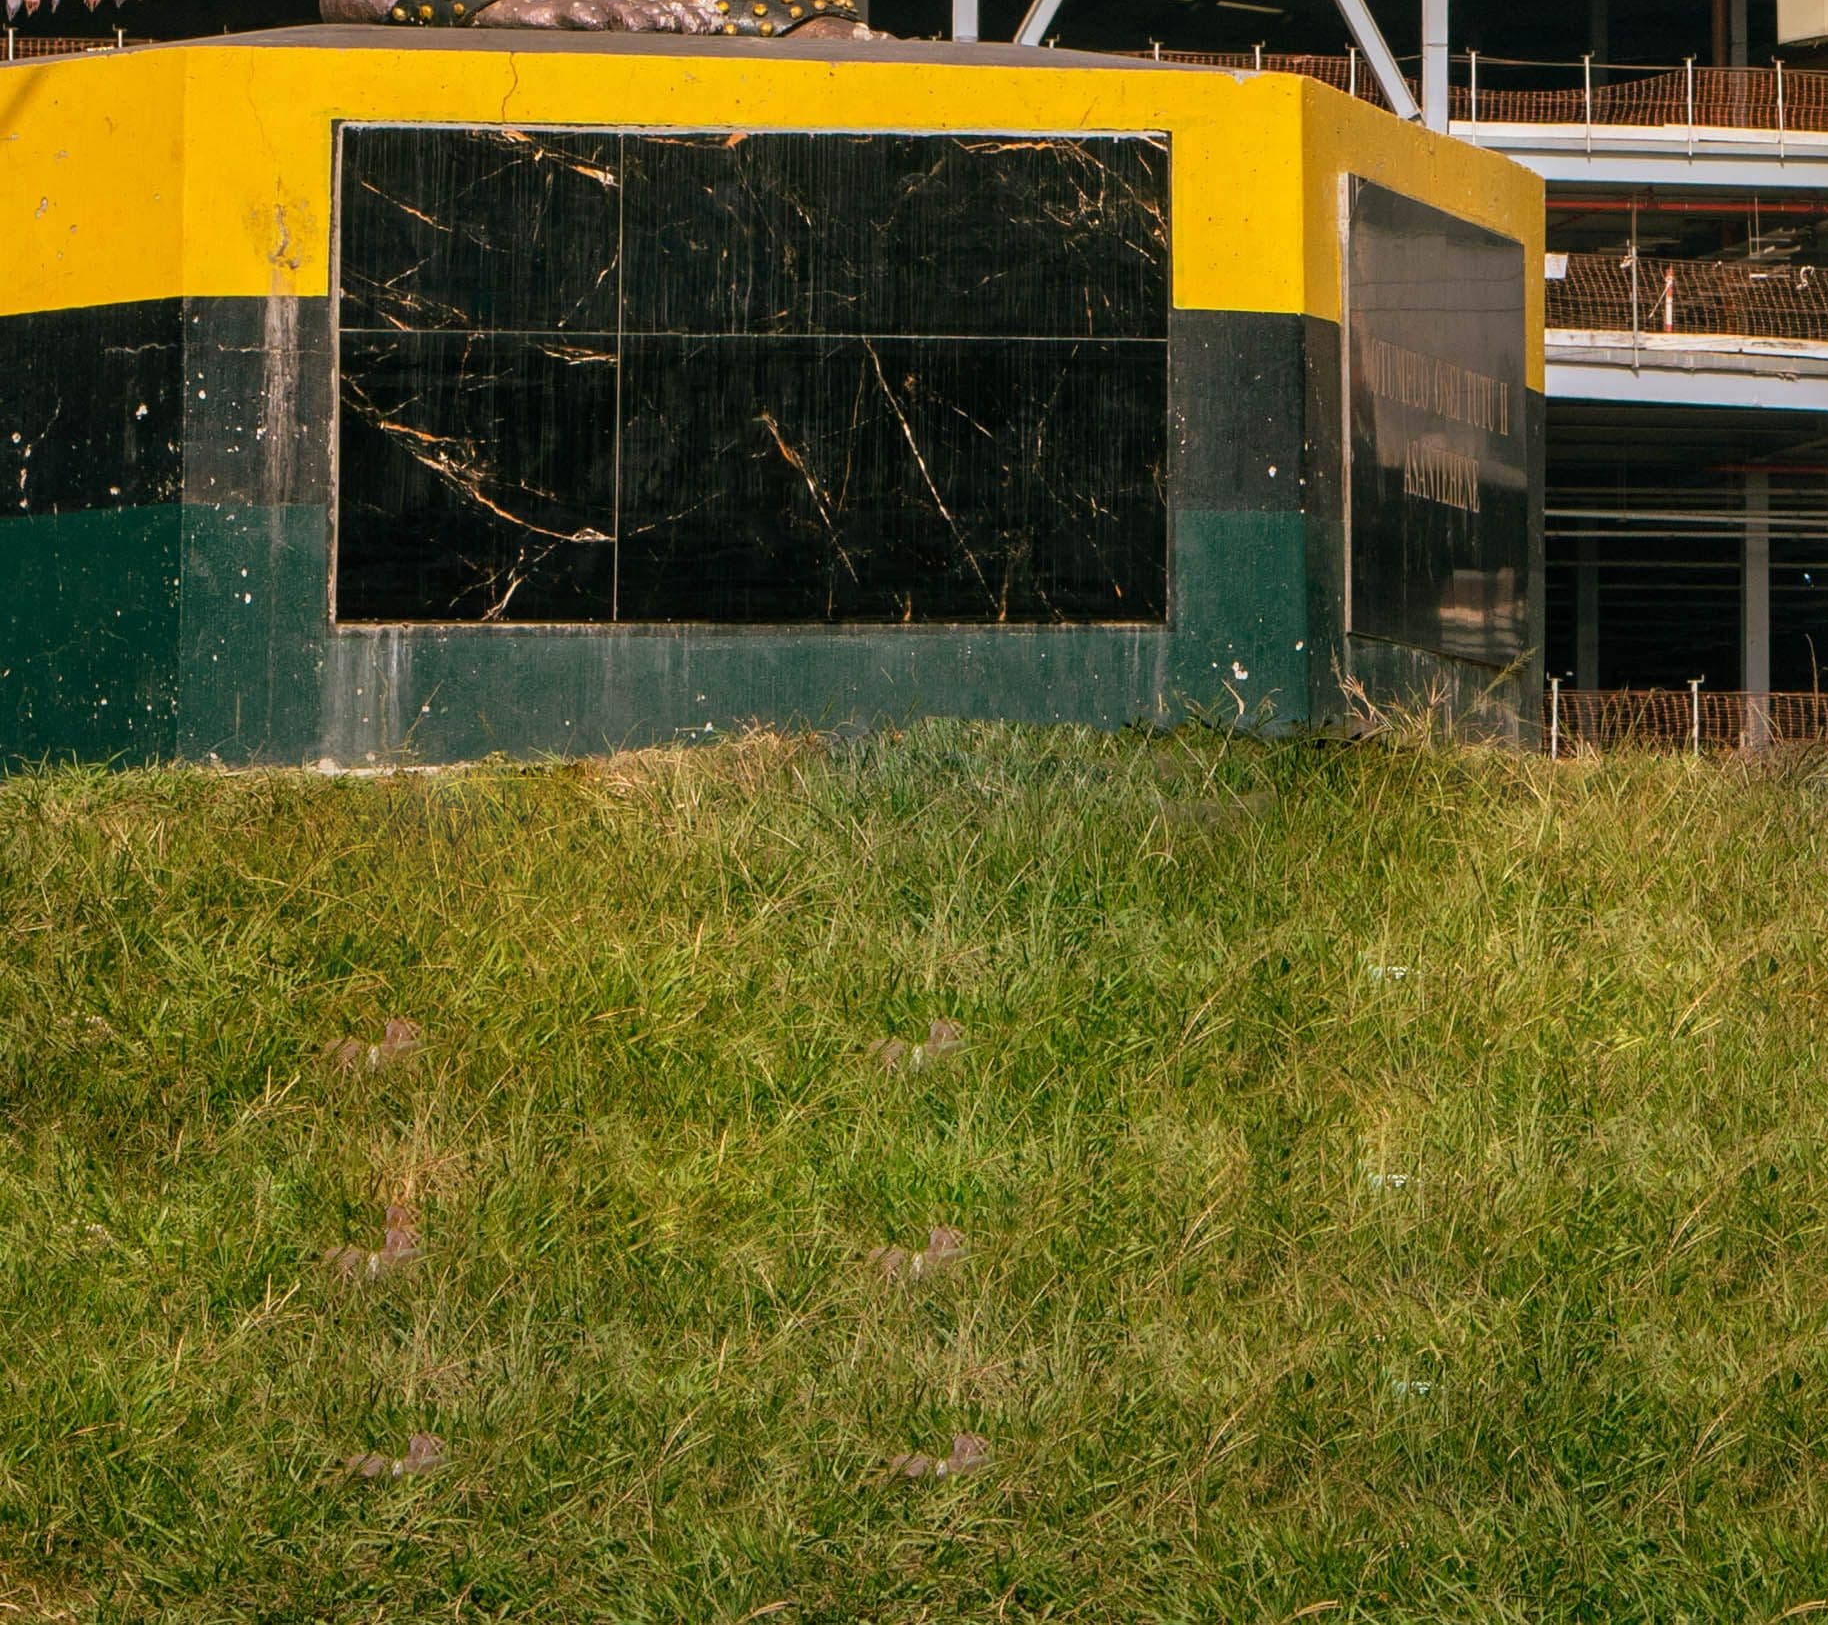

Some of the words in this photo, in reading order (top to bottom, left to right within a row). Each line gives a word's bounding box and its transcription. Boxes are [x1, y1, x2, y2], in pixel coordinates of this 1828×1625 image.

[1434, 359, 1461, 421] OSEI
[1464, 371, 1496, 432] TUTU
[1500, 382, 1509, 436] II
[1404, 438, 1480, 513] ASANTEHENE
